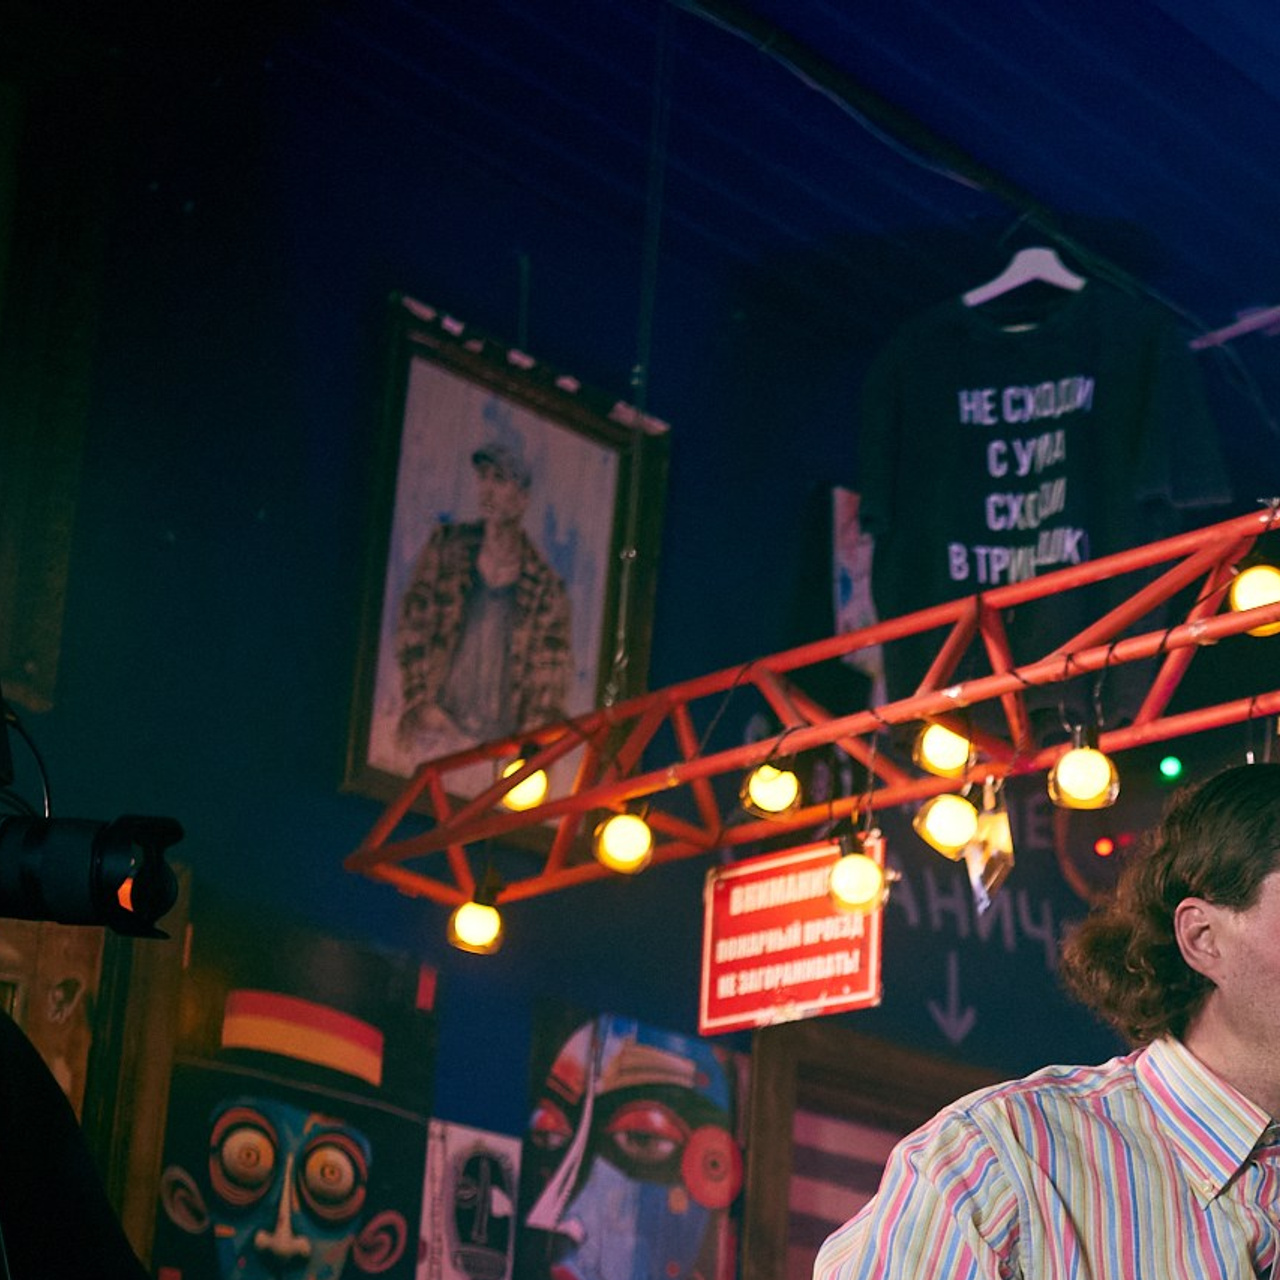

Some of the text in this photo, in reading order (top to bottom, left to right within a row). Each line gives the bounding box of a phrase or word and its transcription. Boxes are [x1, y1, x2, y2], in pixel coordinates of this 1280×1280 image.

[958, 388, 998, 425] НЕ
[986, 438, 1009, 478] С
[947, 541, 970, 581] В
